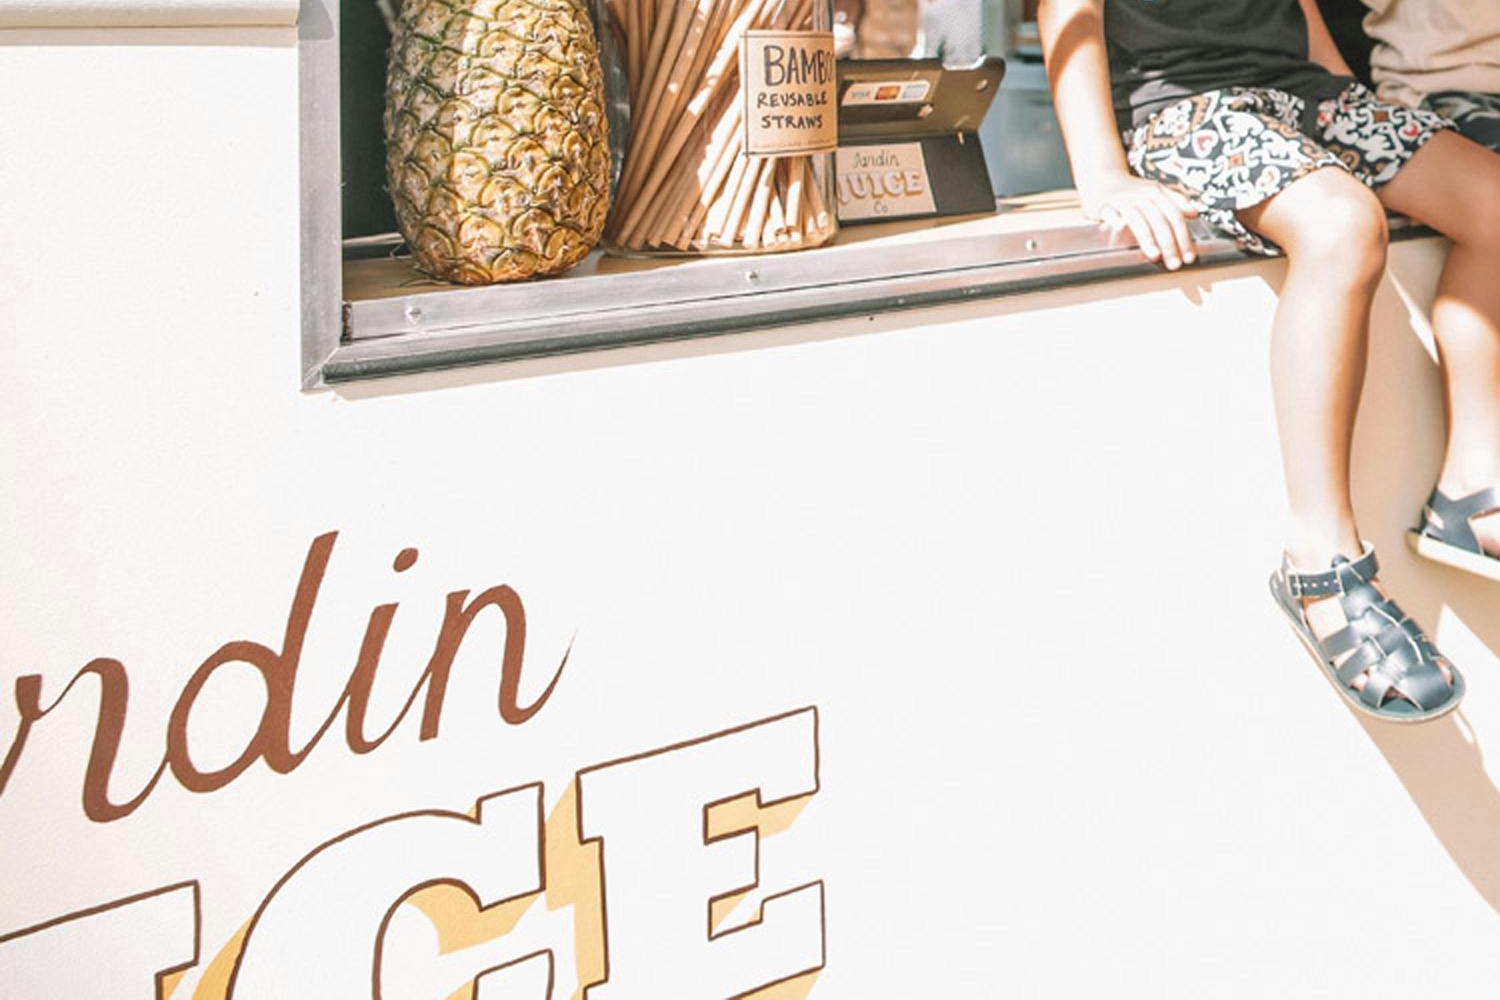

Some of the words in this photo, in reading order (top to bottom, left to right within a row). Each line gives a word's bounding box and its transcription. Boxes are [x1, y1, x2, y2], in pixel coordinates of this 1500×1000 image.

[757, 91, 828, 109] REUSABLE
[761, 115, 823, 130] STRAWS
[837, 170, 924, 205] JUICE
